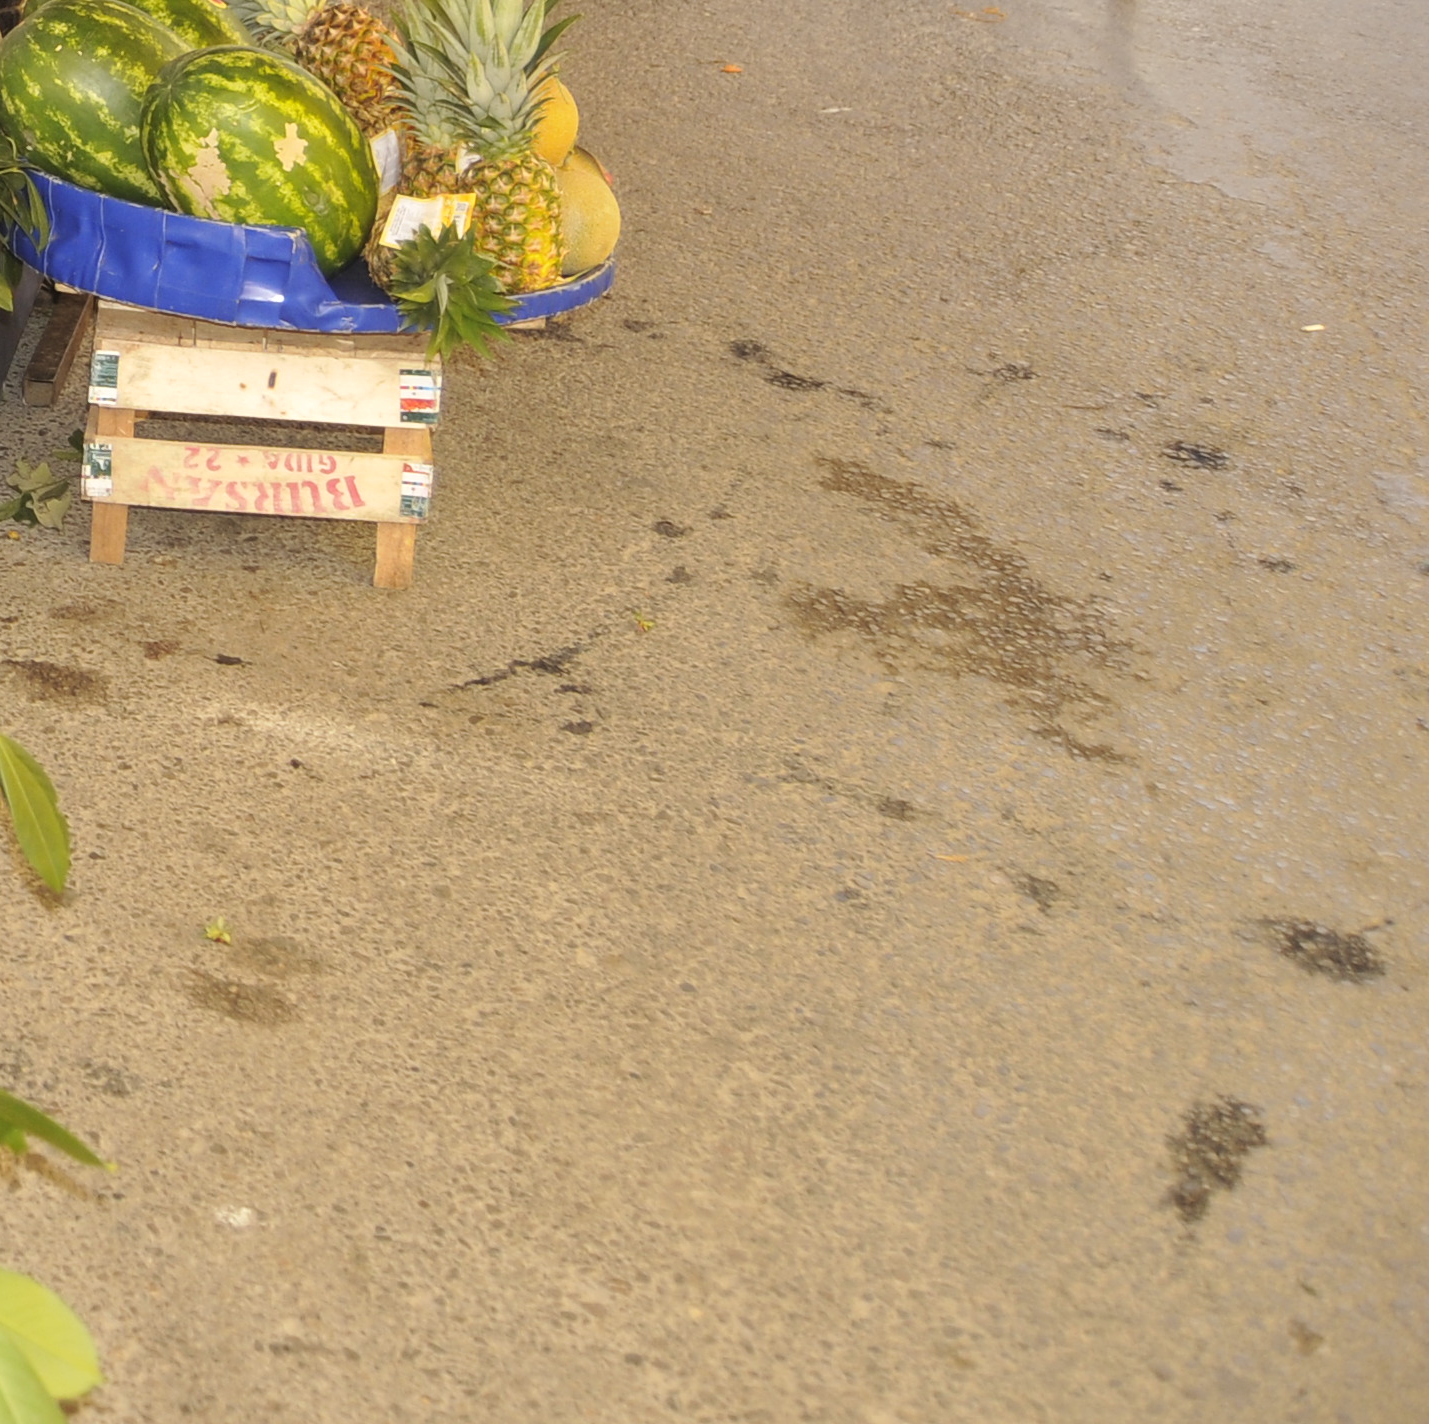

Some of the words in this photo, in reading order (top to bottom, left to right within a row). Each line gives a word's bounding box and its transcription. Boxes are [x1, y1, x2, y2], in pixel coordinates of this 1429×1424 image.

[184, 446, 222, 472] 22
[263, 450, 337, 475] GIDA
[142, 465, 367, 517] BURSAN
